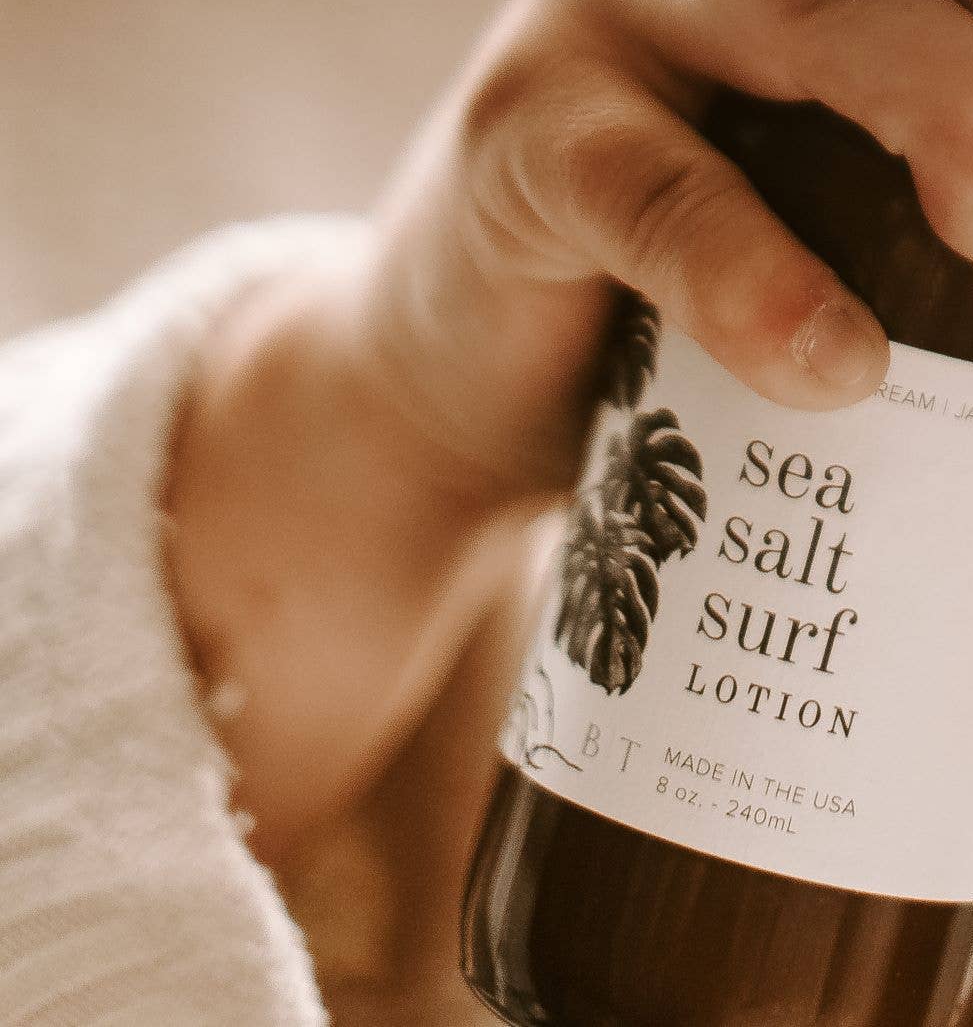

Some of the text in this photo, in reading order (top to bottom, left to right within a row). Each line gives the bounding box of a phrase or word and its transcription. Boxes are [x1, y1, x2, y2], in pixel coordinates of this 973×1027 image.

[875, 381, 936, 412] REAM
[739, 439, 855, 514] sea
[718, 515, 853, 594] salt
[696, 592, 858, 674] surf
[685, 662, 859, 739] LOTION
[656, 775, 669, 794] 8
[675, 787, 702, 808] oz.
[726, 799, 797, 835] 240mL
[664, 747, 856, 817] MADE IN THE USA
